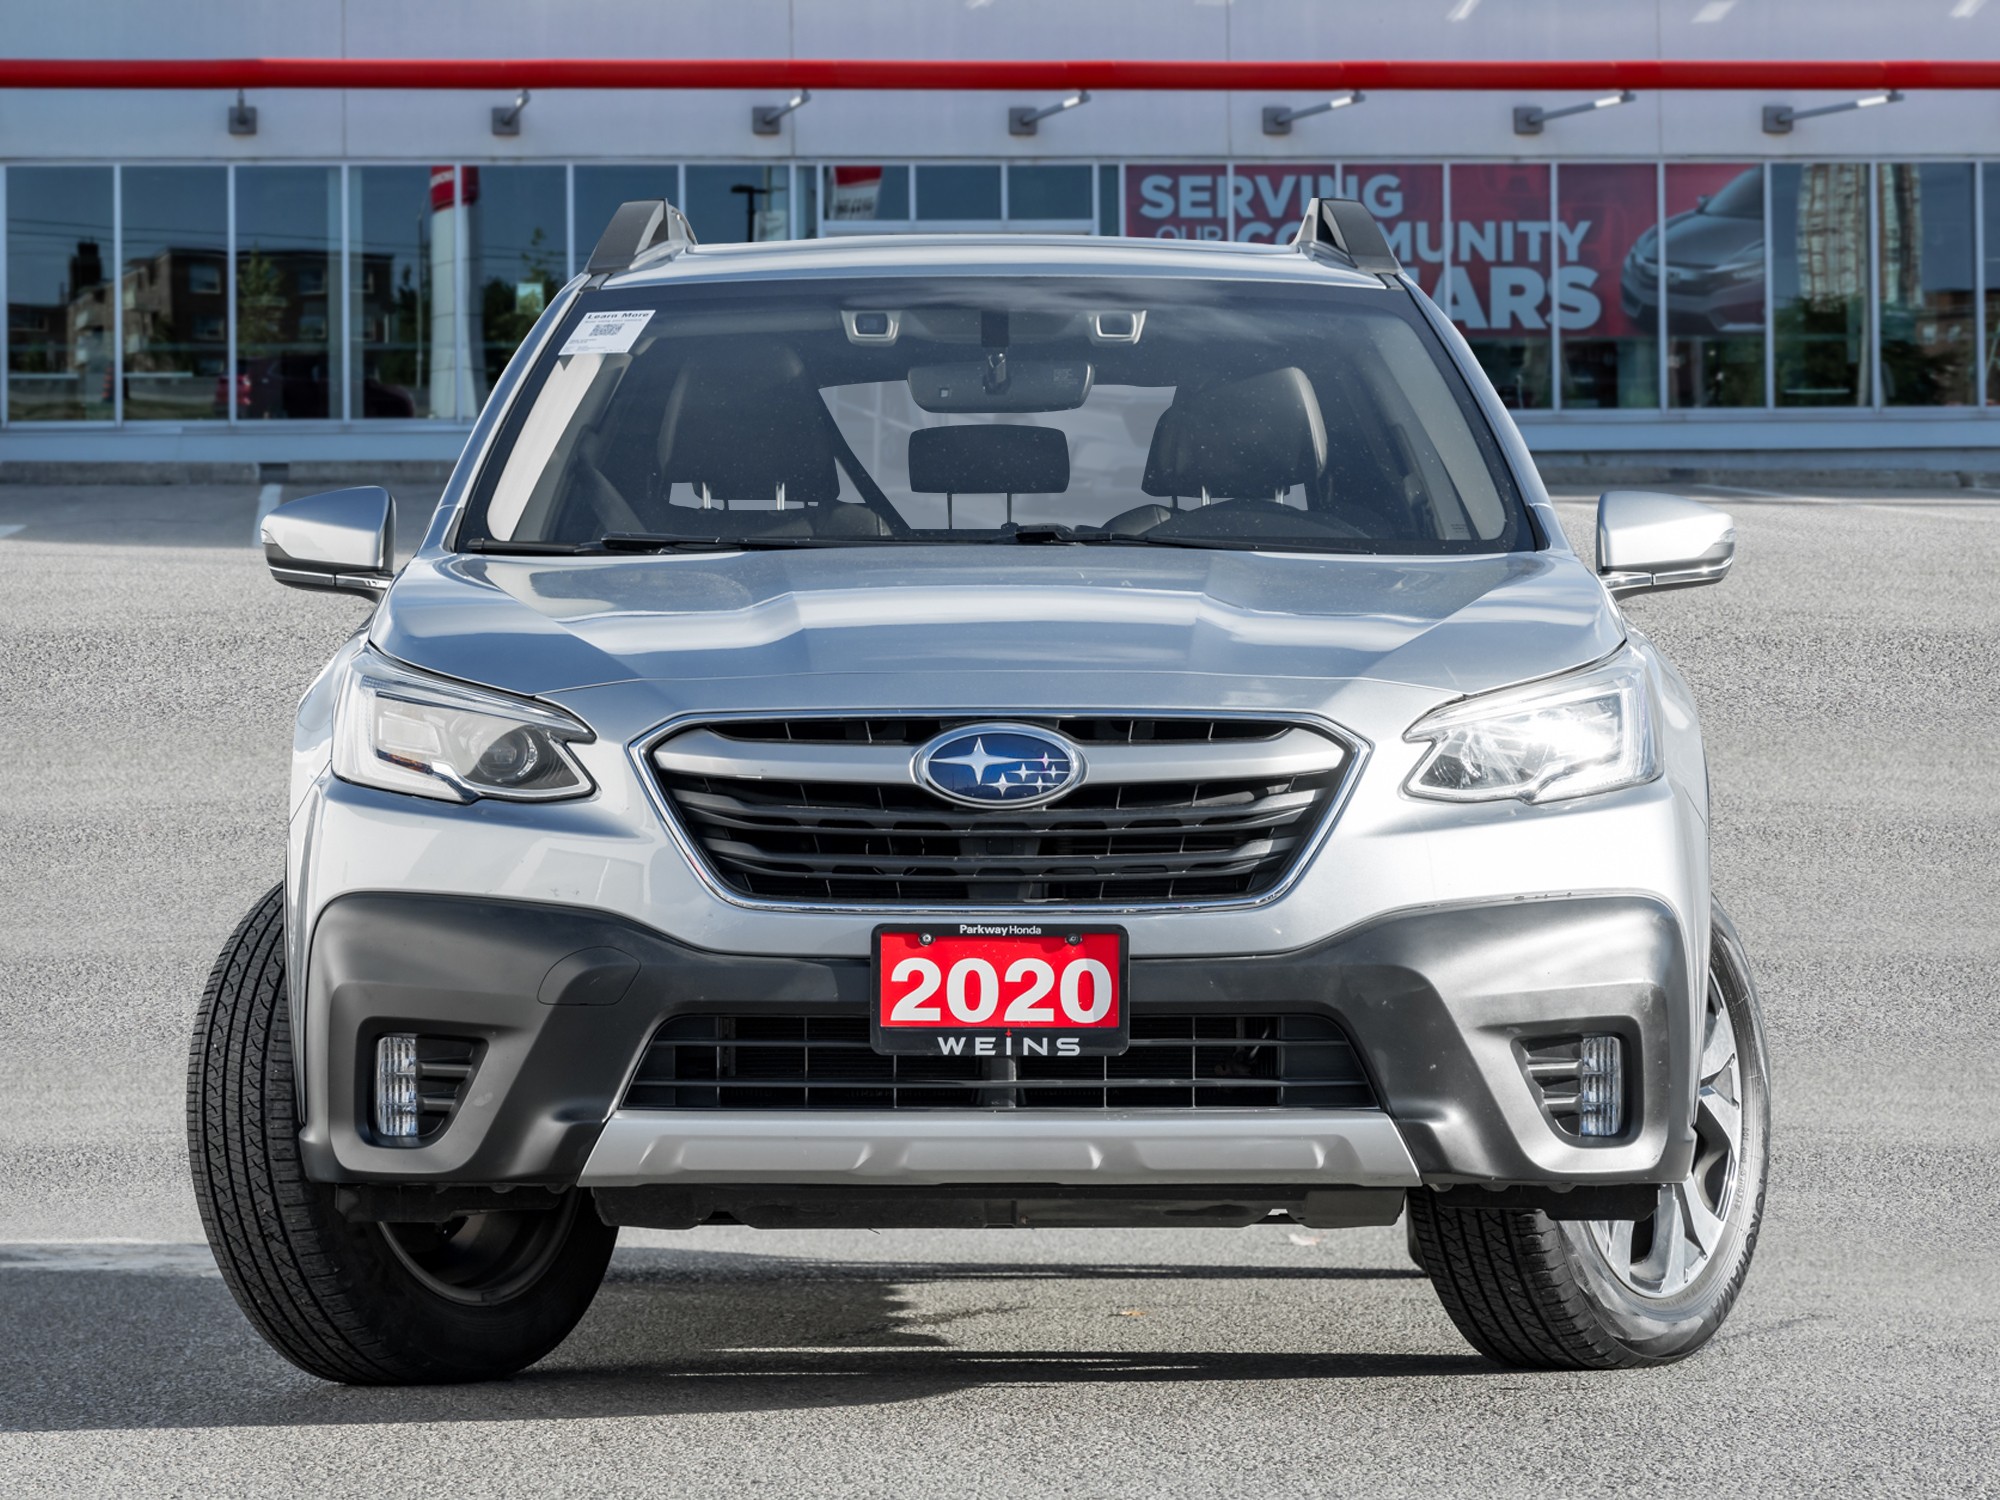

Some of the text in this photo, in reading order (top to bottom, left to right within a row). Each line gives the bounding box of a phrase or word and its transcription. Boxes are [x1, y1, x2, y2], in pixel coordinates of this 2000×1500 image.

[1139, 174, 1403, 218] SERVING
[1237, 221, 1592, 263] CMUNITY
[959, 924, 1042, 936] Parkway Honda
[890, 957, 1113, 1023] 2020
[1710, 1178, 1767, 1323] YOKOHAMA
